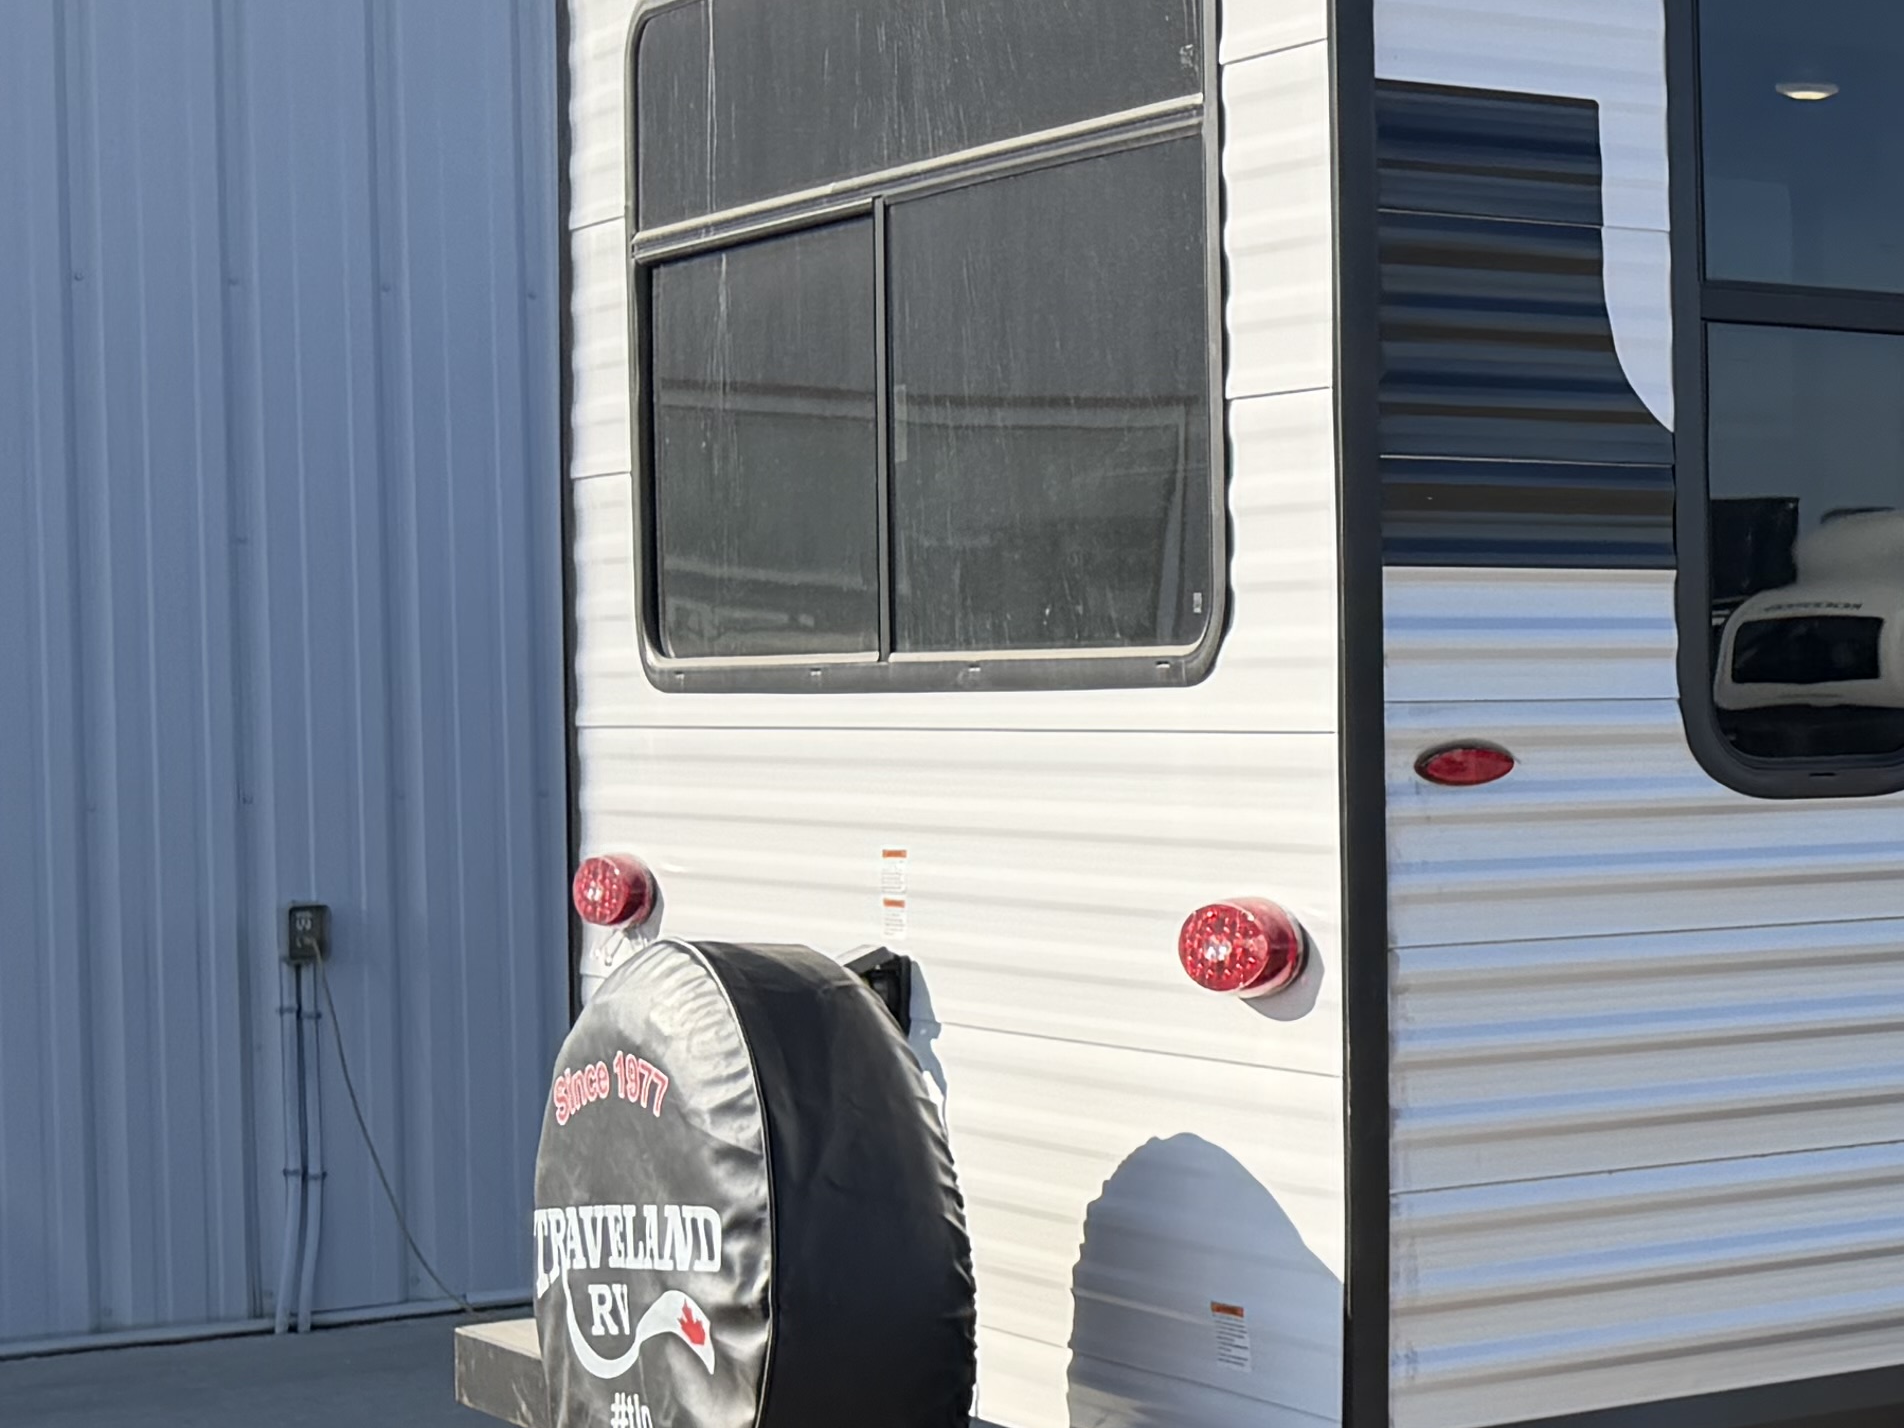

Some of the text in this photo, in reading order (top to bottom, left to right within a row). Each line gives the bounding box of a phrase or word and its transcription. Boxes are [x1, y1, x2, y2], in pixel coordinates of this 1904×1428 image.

[553, 1049, 669, 1127] Since 1977
[534, 1203, 722, 1299] TRAVELAND
[588, 1283, 630, 1336] RV
